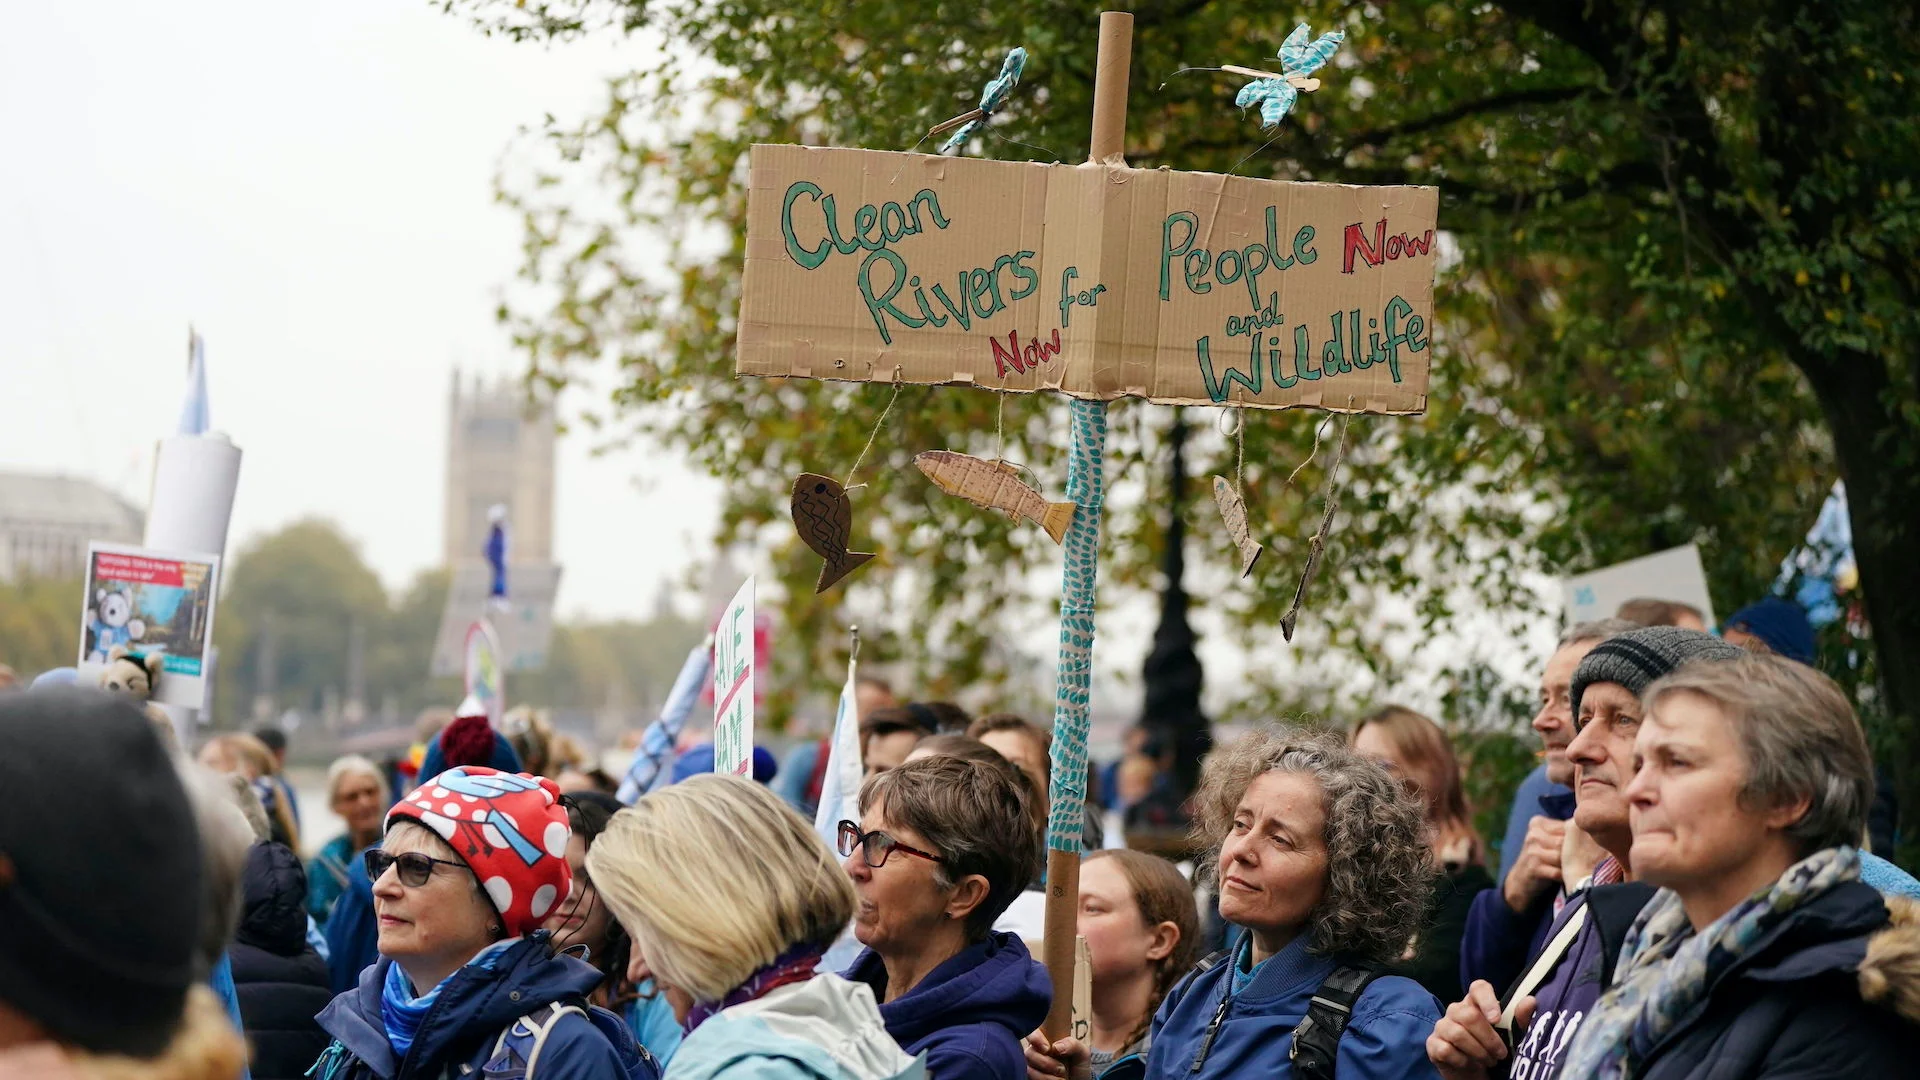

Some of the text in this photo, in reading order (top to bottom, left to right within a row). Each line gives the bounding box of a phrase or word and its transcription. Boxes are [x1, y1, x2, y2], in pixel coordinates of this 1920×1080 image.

[782, 180, 951, 270] Clean
[1158, 205, 1433, 311] People Now
[858, 248, 1107, 344] Rivers for
[1226, 291, 1284, 337] and
[989, 328, 1061, 378] Now
